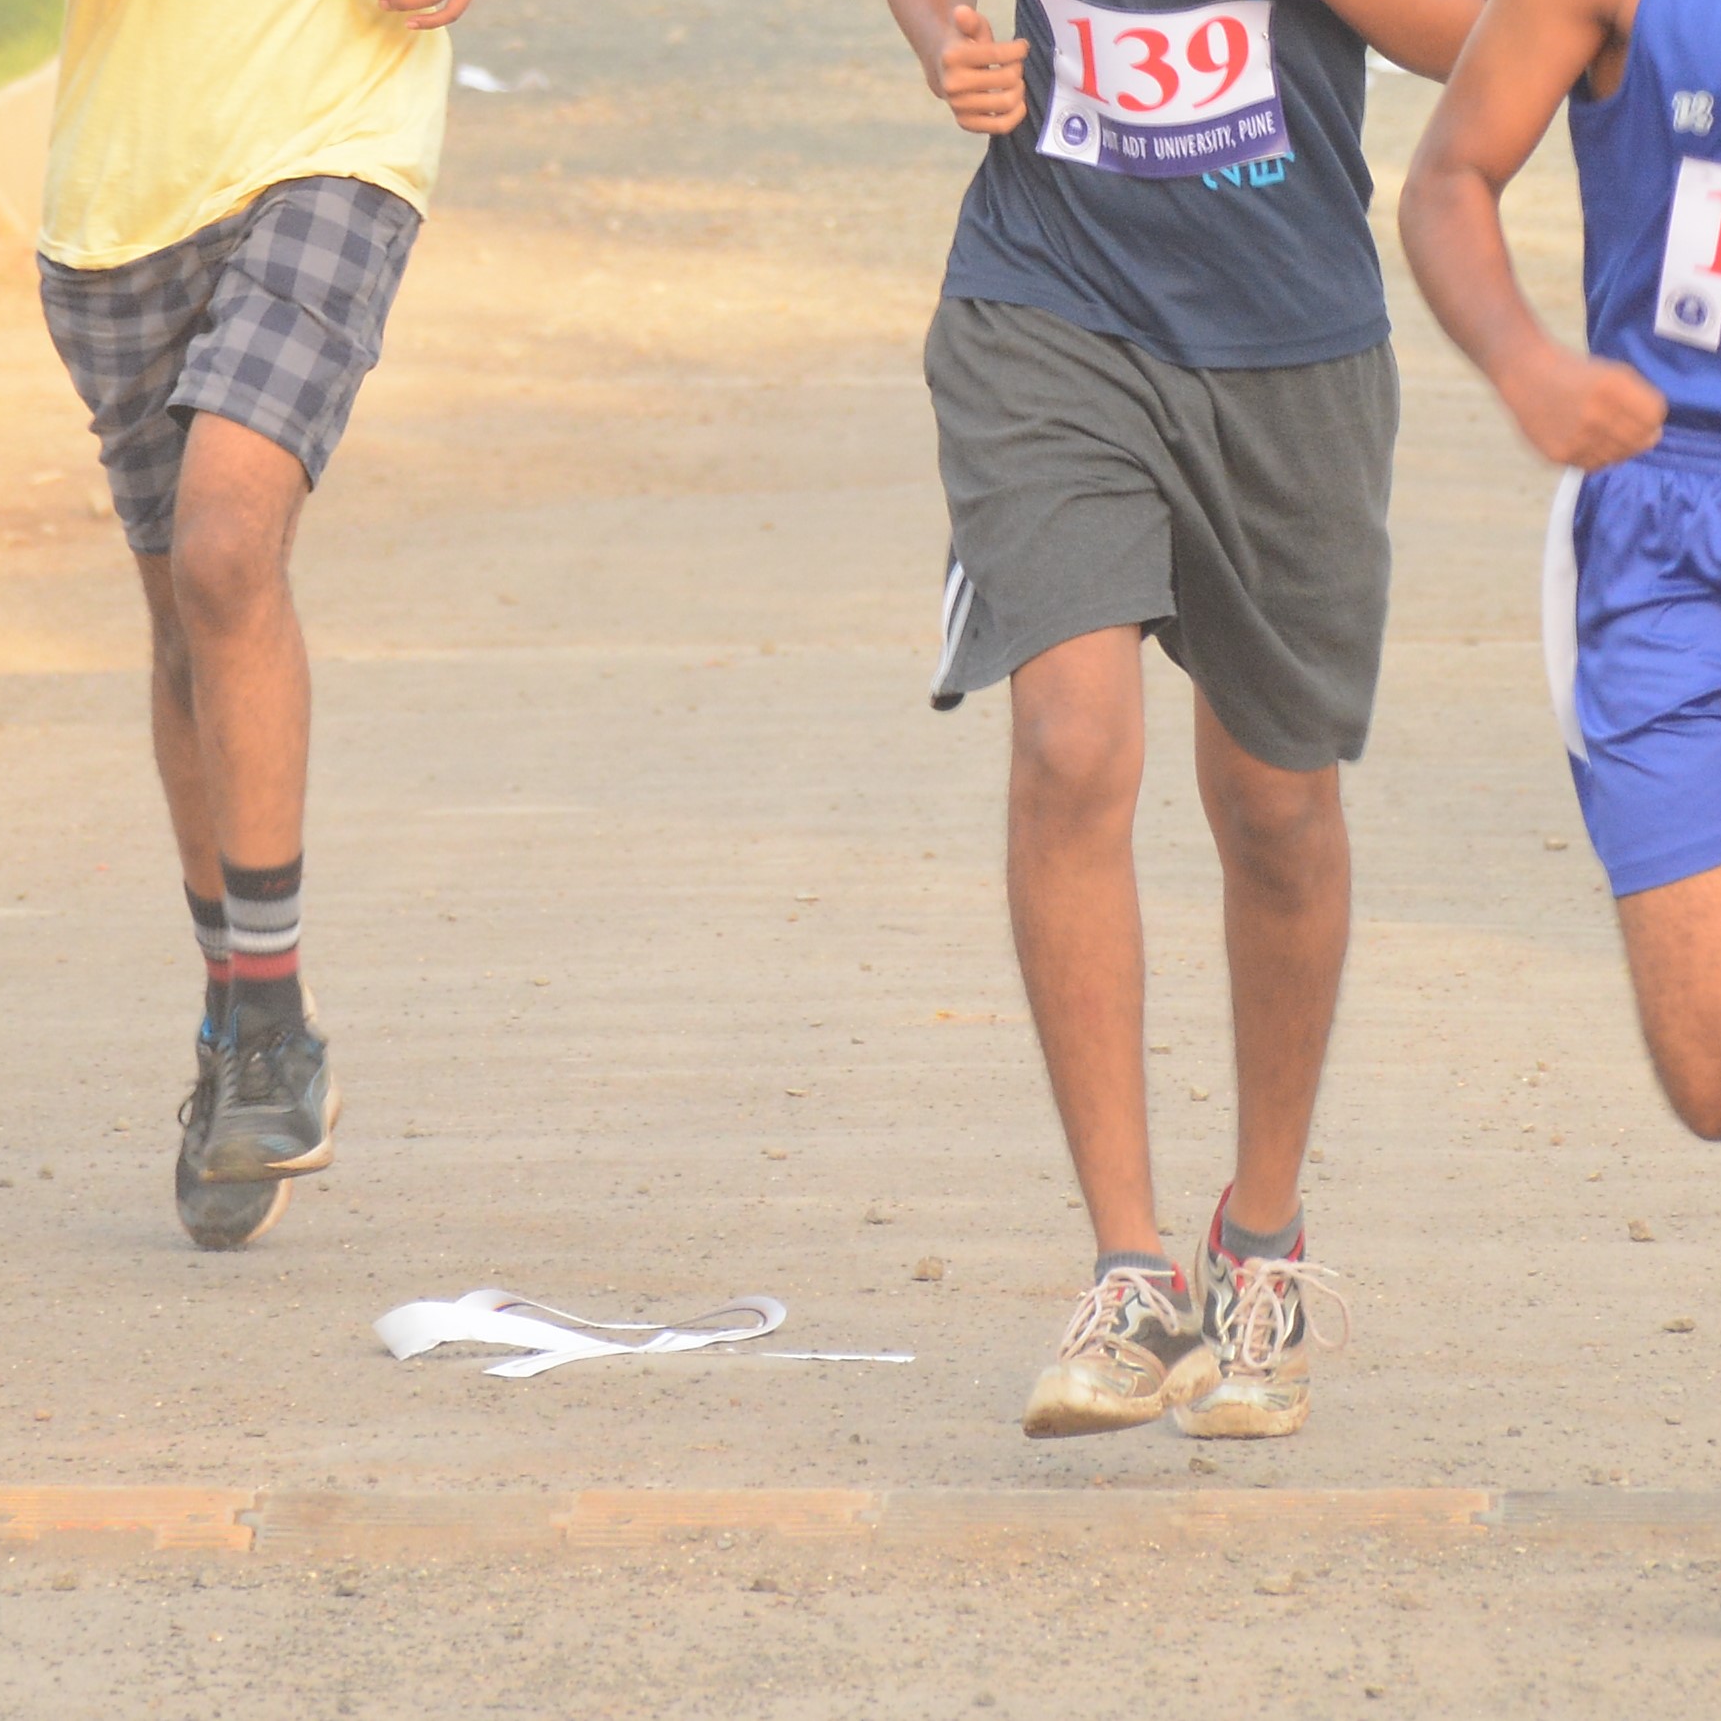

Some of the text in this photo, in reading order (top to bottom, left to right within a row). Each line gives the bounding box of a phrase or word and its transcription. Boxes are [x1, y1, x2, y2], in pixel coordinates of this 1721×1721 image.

[1067, 14, 1250, 113] 139
[1122, 136, 1148, 160] ADT
[1153, 125, 1237, 160] UNIVERSITY,
[1237, 110, 1276, 141] PUNE
